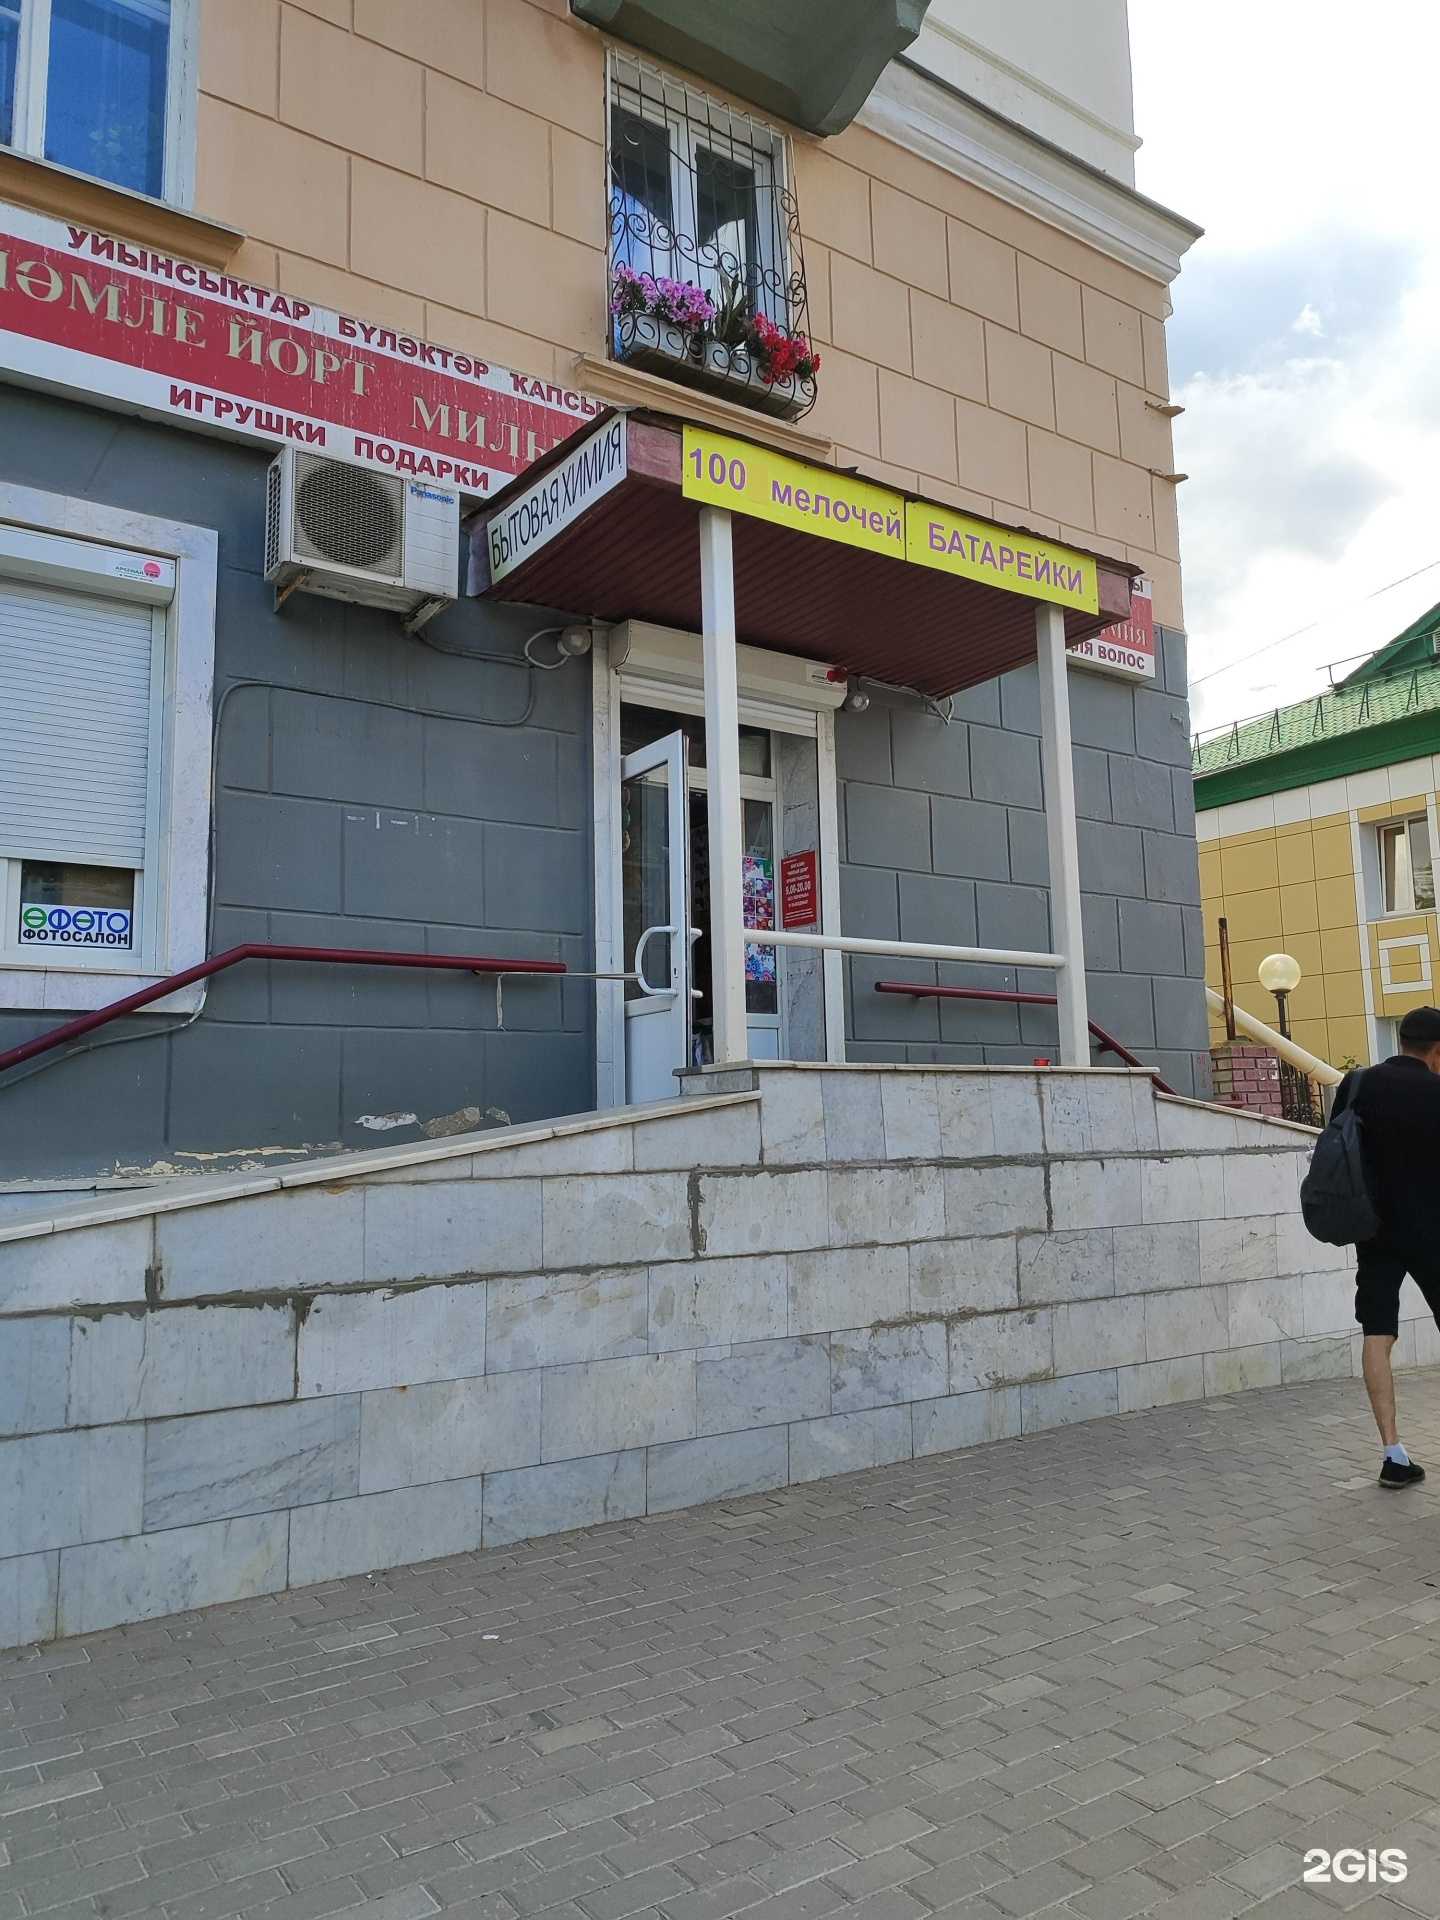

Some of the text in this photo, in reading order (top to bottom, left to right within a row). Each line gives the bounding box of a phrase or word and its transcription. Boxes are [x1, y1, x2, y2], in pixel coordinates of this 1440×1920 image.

[226, 313, 376, 397] ЙОРТ
[170, 384, 489, 491] ИГРУШКИ ПОДАРКИ
[411, 486, 455, 504] Panasonic
[491, 421, 621, 570] БЫТОВАЯ ХИМИЯ
[688, 447, 902, 542] 100 мелочей
[928, 522, 1083, 596] БАТАРЕЙКИ
[1098, 645, 1145, 669] ВОЛОС
[23, 929, 128, 944] ФОТОСАЛОН
